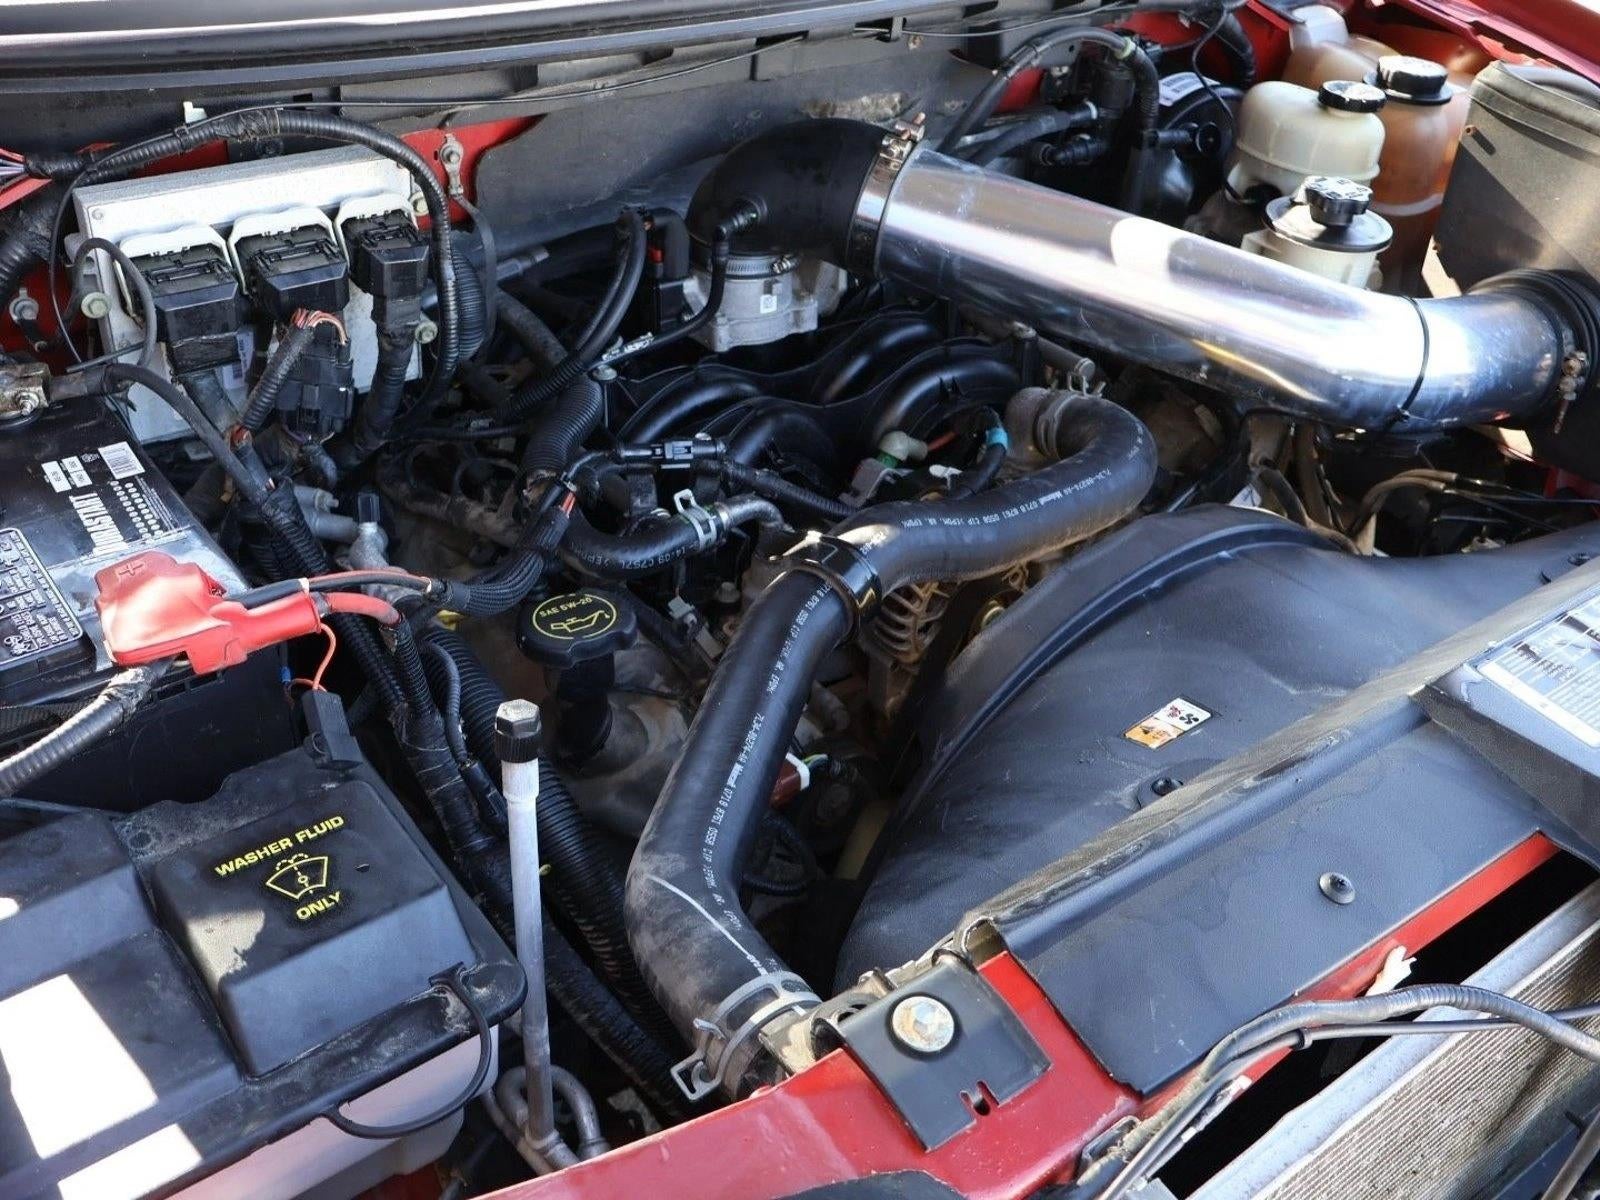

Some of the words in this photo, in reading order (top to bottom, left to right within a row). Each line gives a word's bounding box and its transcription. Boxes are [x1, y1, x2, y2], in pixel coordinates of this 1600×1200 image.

[539, 606, 559, 618] SAE
[560, 597, 593, 612] 5W-20
[719, 787, 733, 807] 0718
[711, 807, 725, 826] 8761
[214, 837, 293, 877] WASHER
[295, 816, 344, 843] FLUID
[296, 891, 340, 920] ONLY
